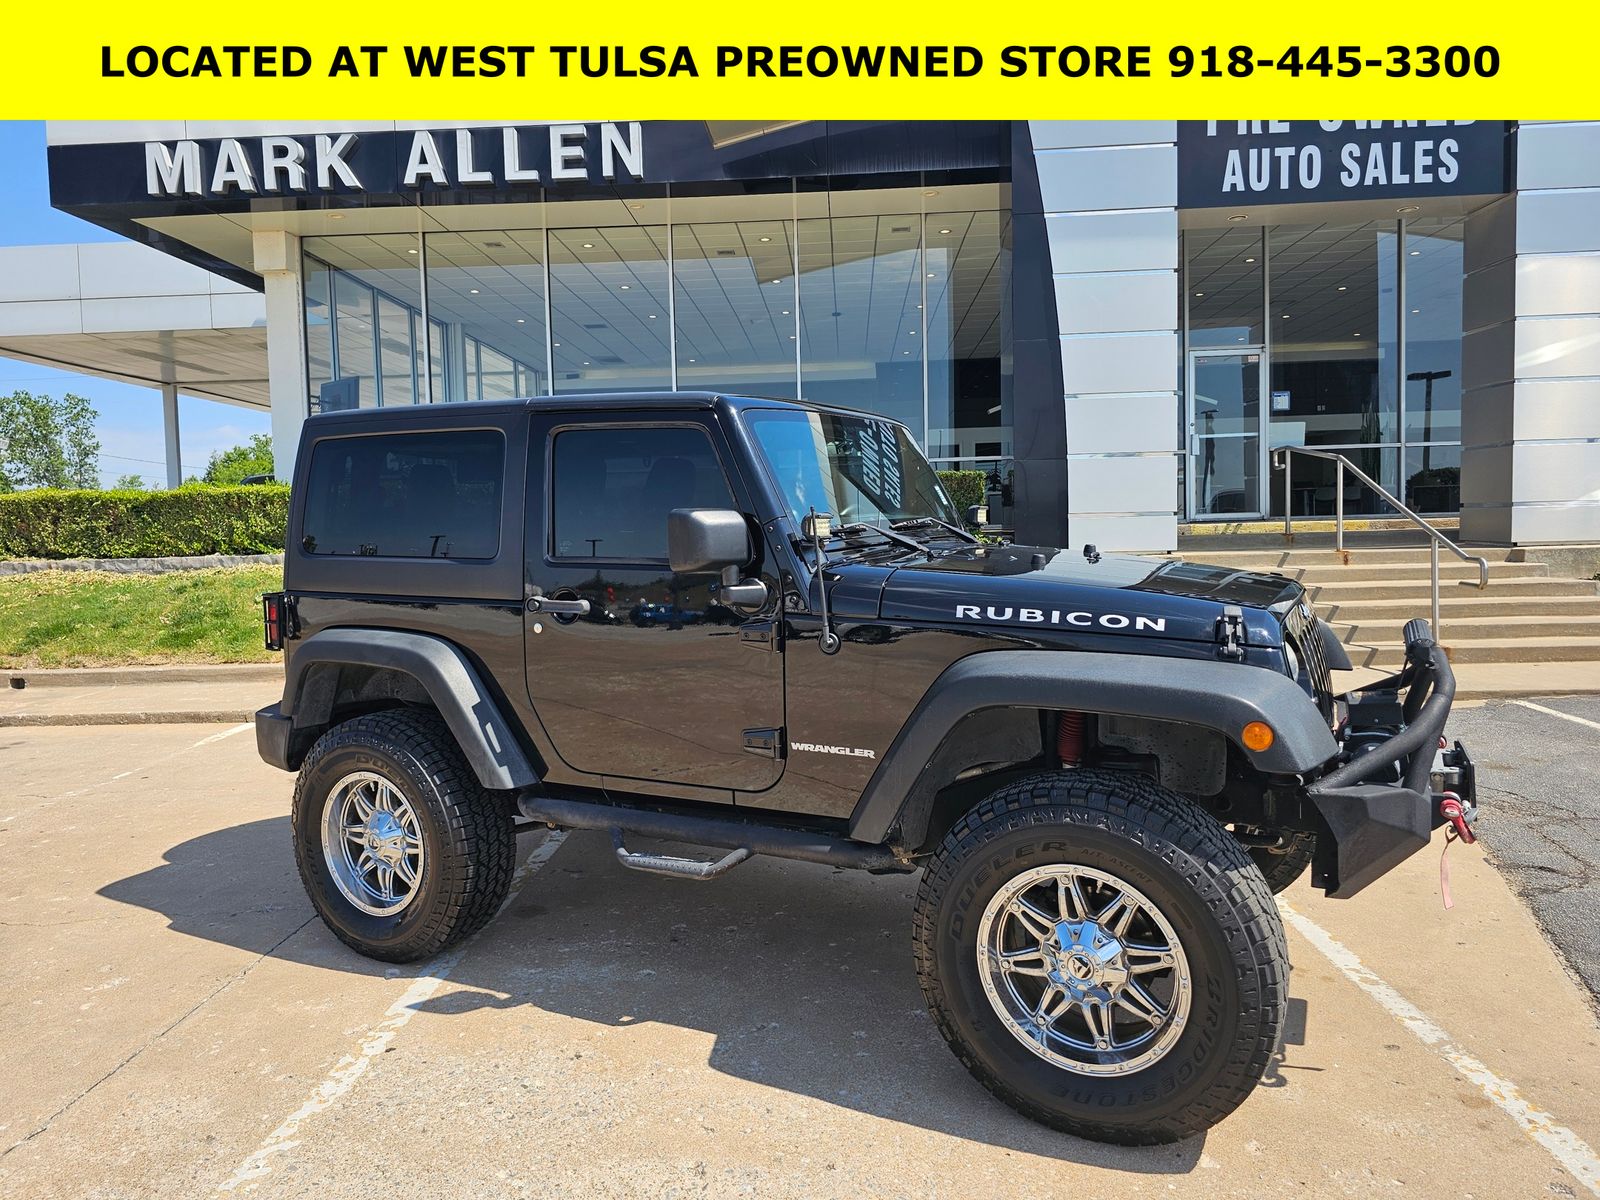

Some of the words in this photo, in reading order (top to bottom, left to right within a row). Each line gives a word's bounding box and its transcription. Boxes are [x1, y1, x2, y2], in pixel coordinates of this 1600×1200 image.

[145, 133, 364, 198] MARK
[403, 121, 644, 187] ALLEN
[1222, 144, 1322, 192] AUTO
[1340, 138, 1459, 187] SALES
[955, 604, 1166, 632] RUBICON
[790, 742, 876, 759] WRANGLER
[949, 839, 1070, 941] DUELER
